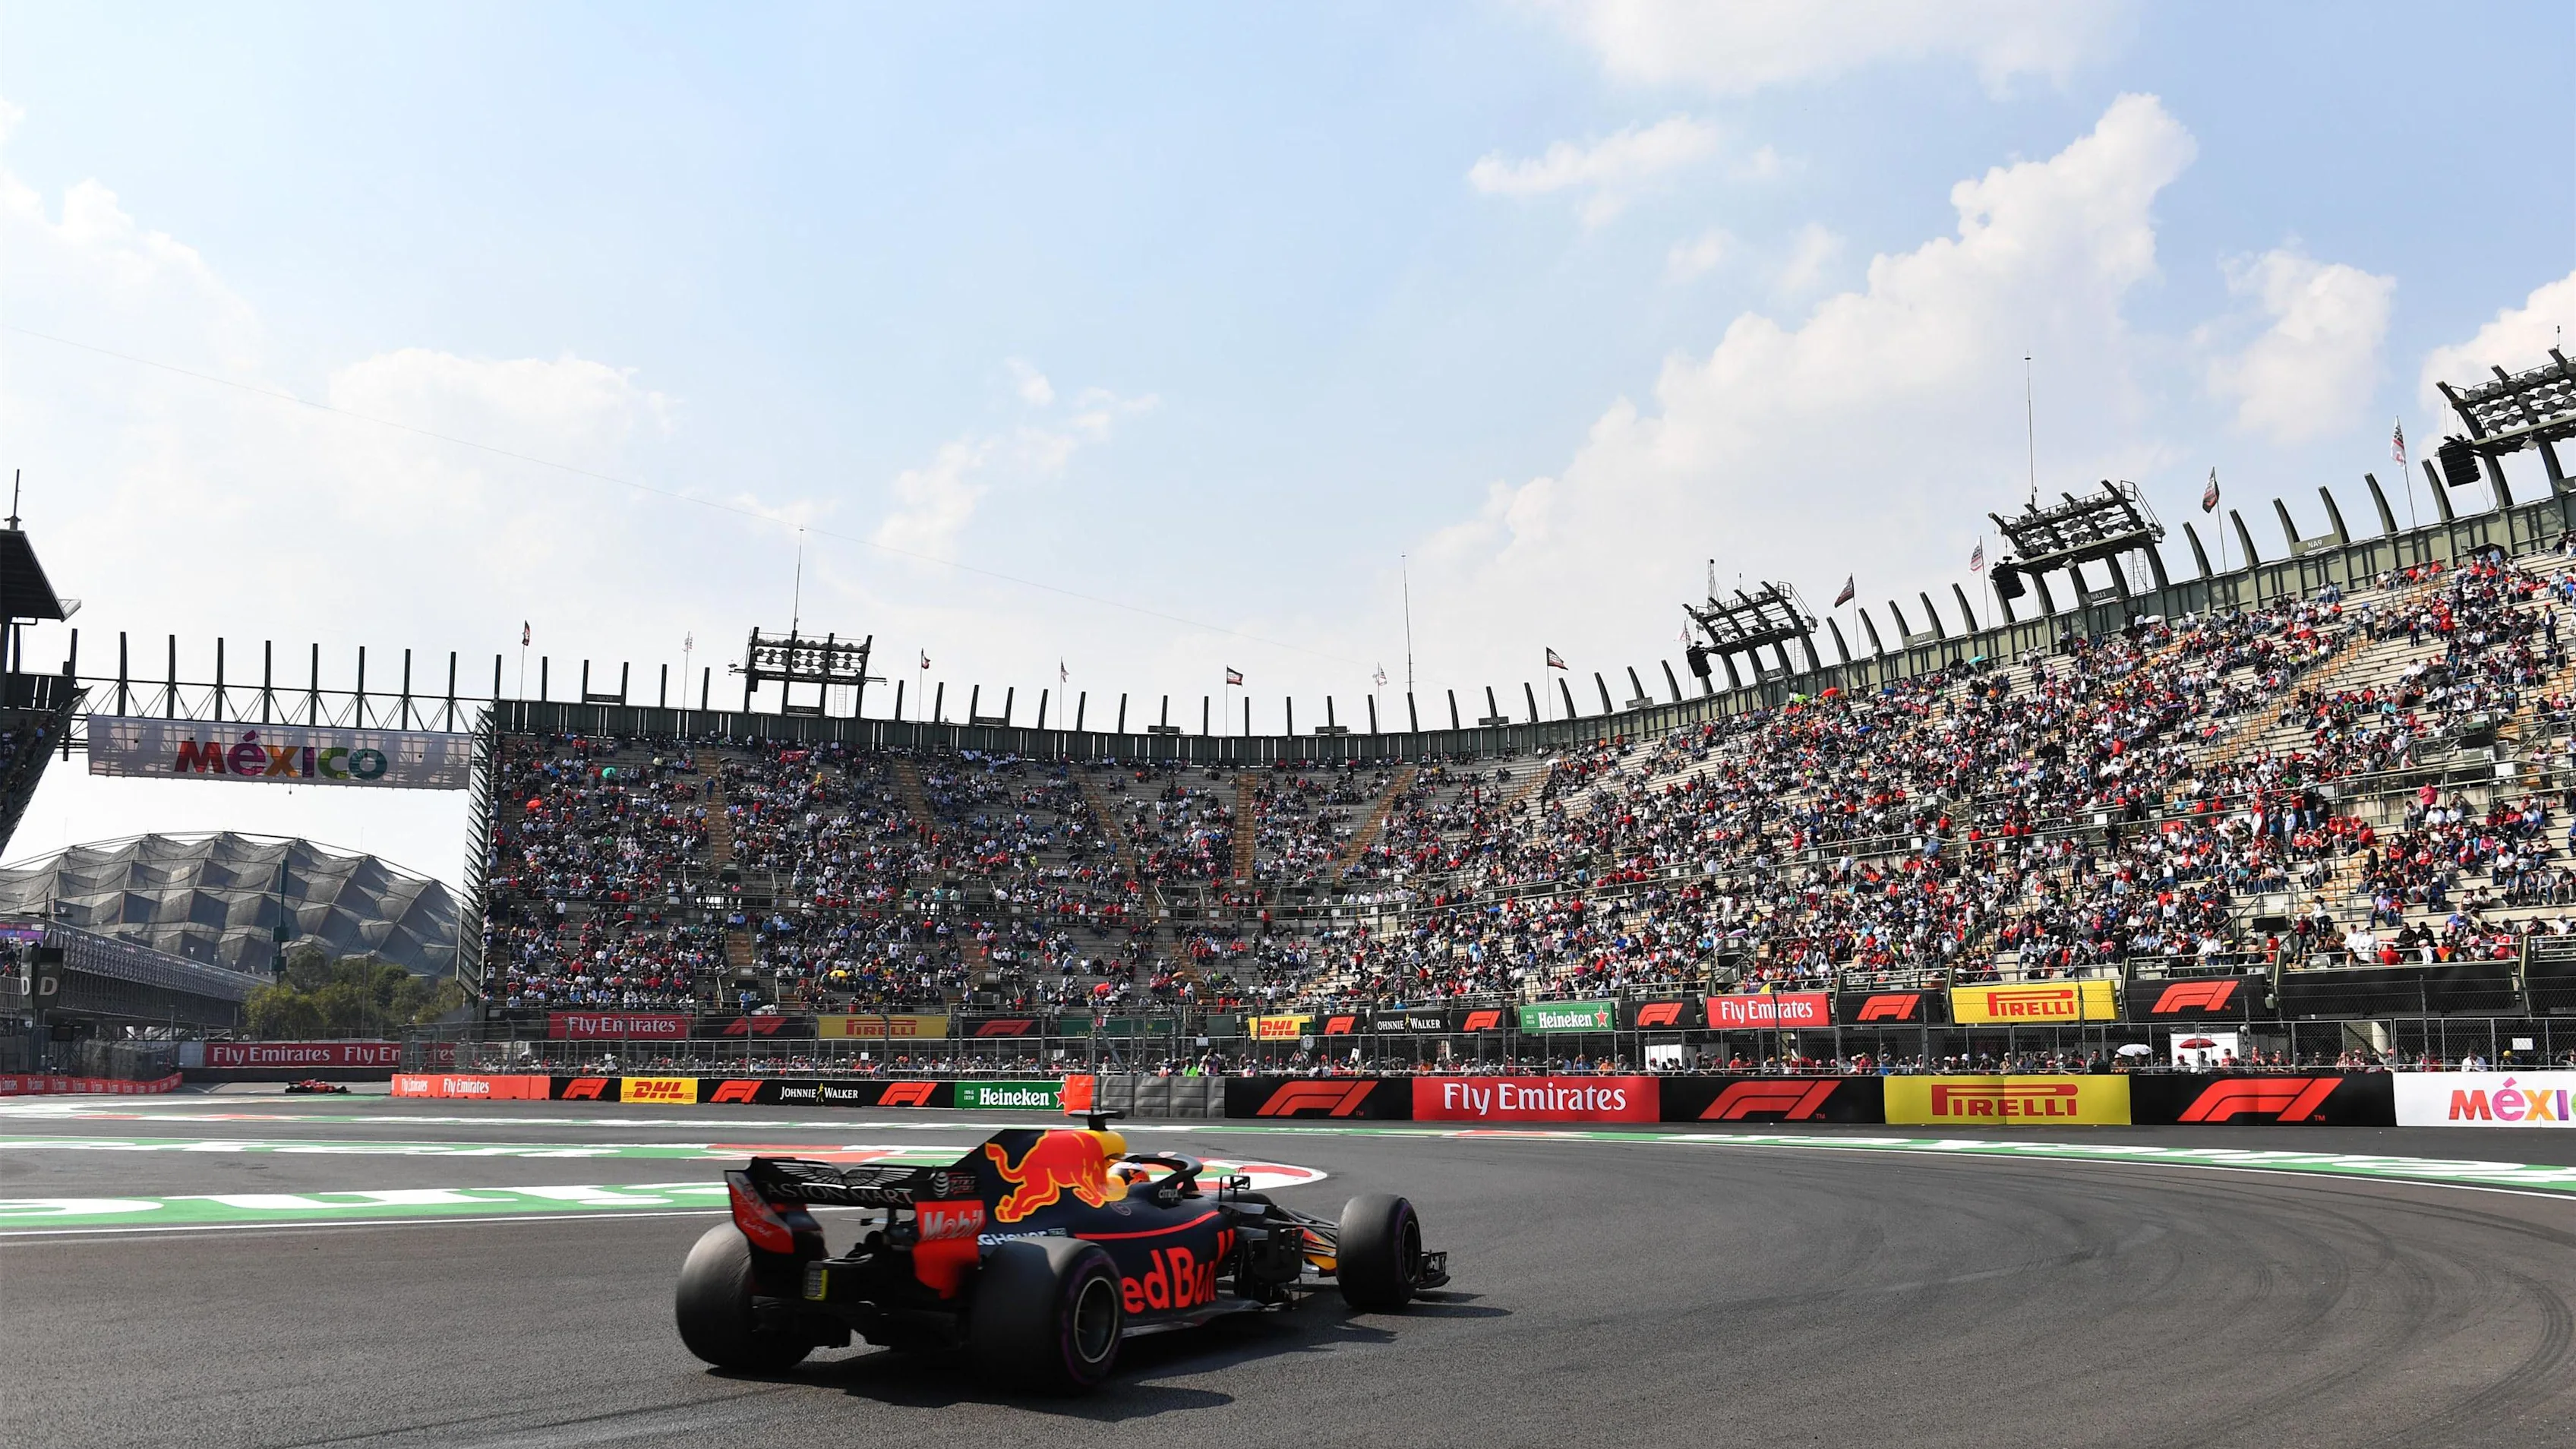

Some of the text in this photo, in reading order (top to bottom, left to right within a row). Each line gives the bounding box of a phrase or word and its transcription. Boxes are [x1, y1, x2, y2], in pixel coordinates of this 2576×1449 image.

[2307, 539, 2324, 550] NA9
[21, 976, 31, 996] D
[39, 976, 58, 996] D
[1721, 999, 1814, 1024] Fly Emirates
[1987, 990, 2074, 1017] PIRELLI
[568, 1016, 676, 1034] Fly Emirates
[845, 1018, 917, 1036] PIRELLI
[1259, 1021, 1296, 1037] DHL
[1373, 1018, 1441, 1031] OHNNIE WALKER
[1537, 1011, 1593, 1029] Heineken
[213, 1046, 330, 1065] Fly Emirates
[344, 1046, 374, 1065] Fly
[443, 1078, 490, 1096] Fly Emirates
[633, 1081, 684, 1098] DHL
[779, 1086, 859, 1100] JOHNNIE WALKER
[979, 1088, 1050, 1106] Heineken
[1443, 1081, 1627, 1116] Fly Emirates
[1931, 1084, 2079, 1116] PIRELLI
[2448, 1077, 2576, 1122] Méxi
[767, 1181, 848, 1200] ASTON
[1121, 1249, 1170, 1314] ed
